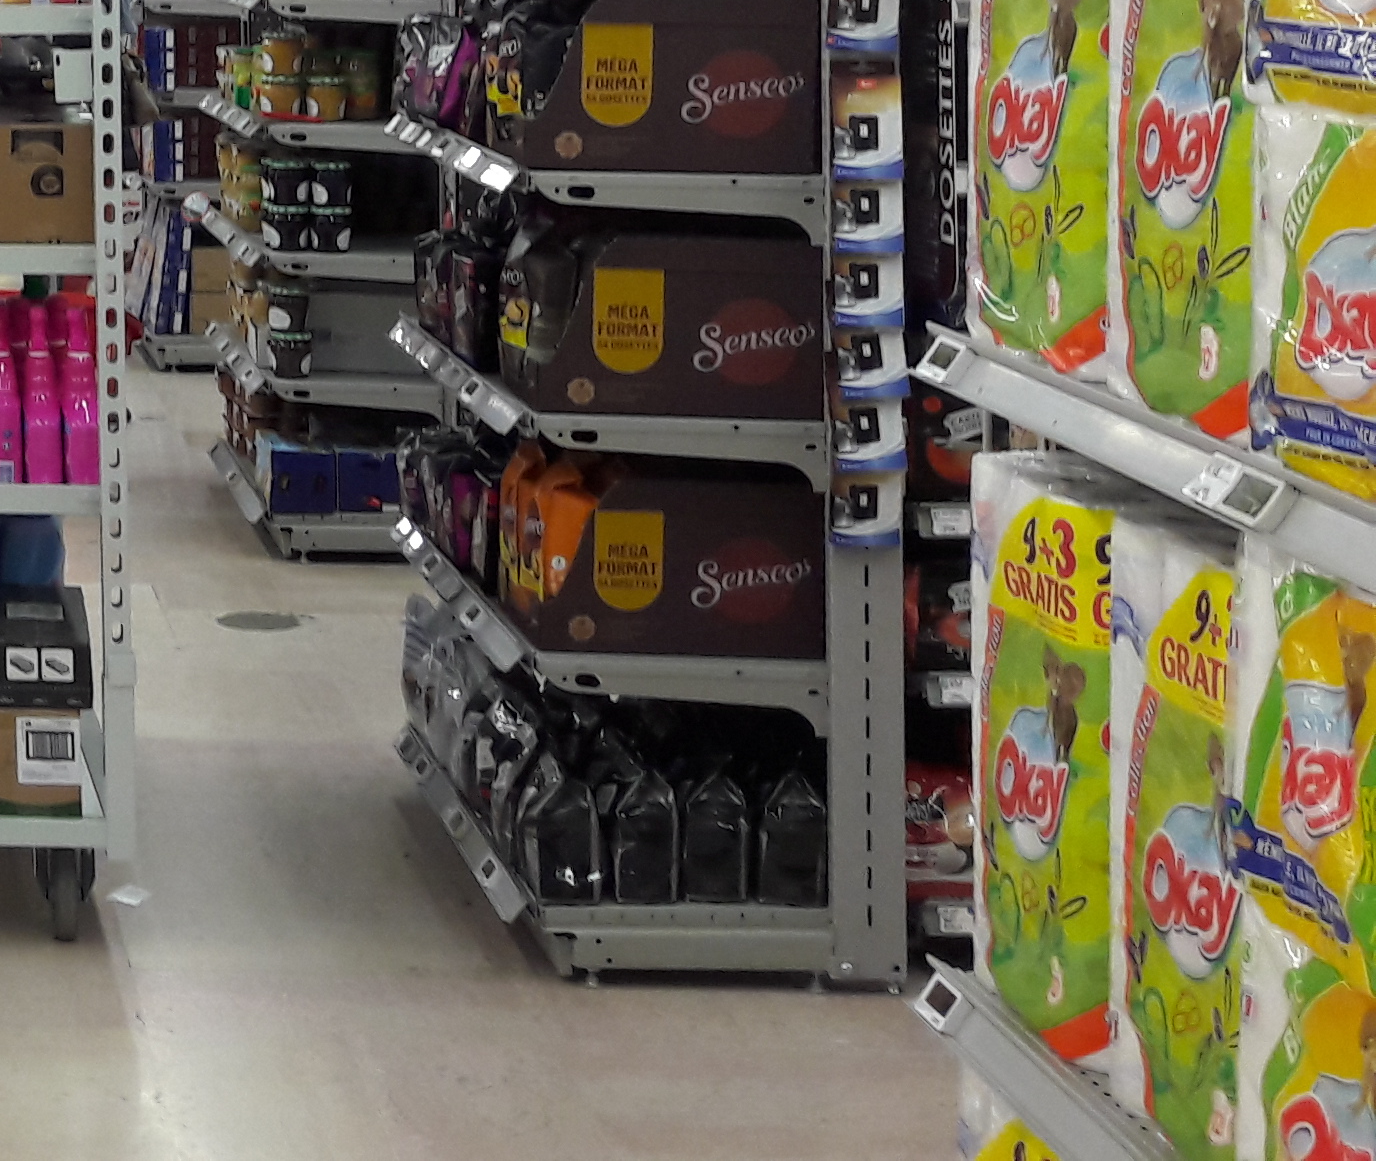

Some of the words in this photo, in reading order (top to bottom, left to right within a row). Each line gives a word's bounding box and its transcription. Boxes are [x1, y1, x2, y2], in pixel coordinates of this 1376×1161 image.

[586, 76, 648, 91] FORMAT
[938, 17, 957, 245] DOSETTES
[988, 73, 1069, 165] Okay
[1135, 95, 1233, 200] Okay
[1003, 560, 1078, 625] GRATIS
[994, 734, 1069, 844] Okay
[1143, 828, 1244, 961] Okay
